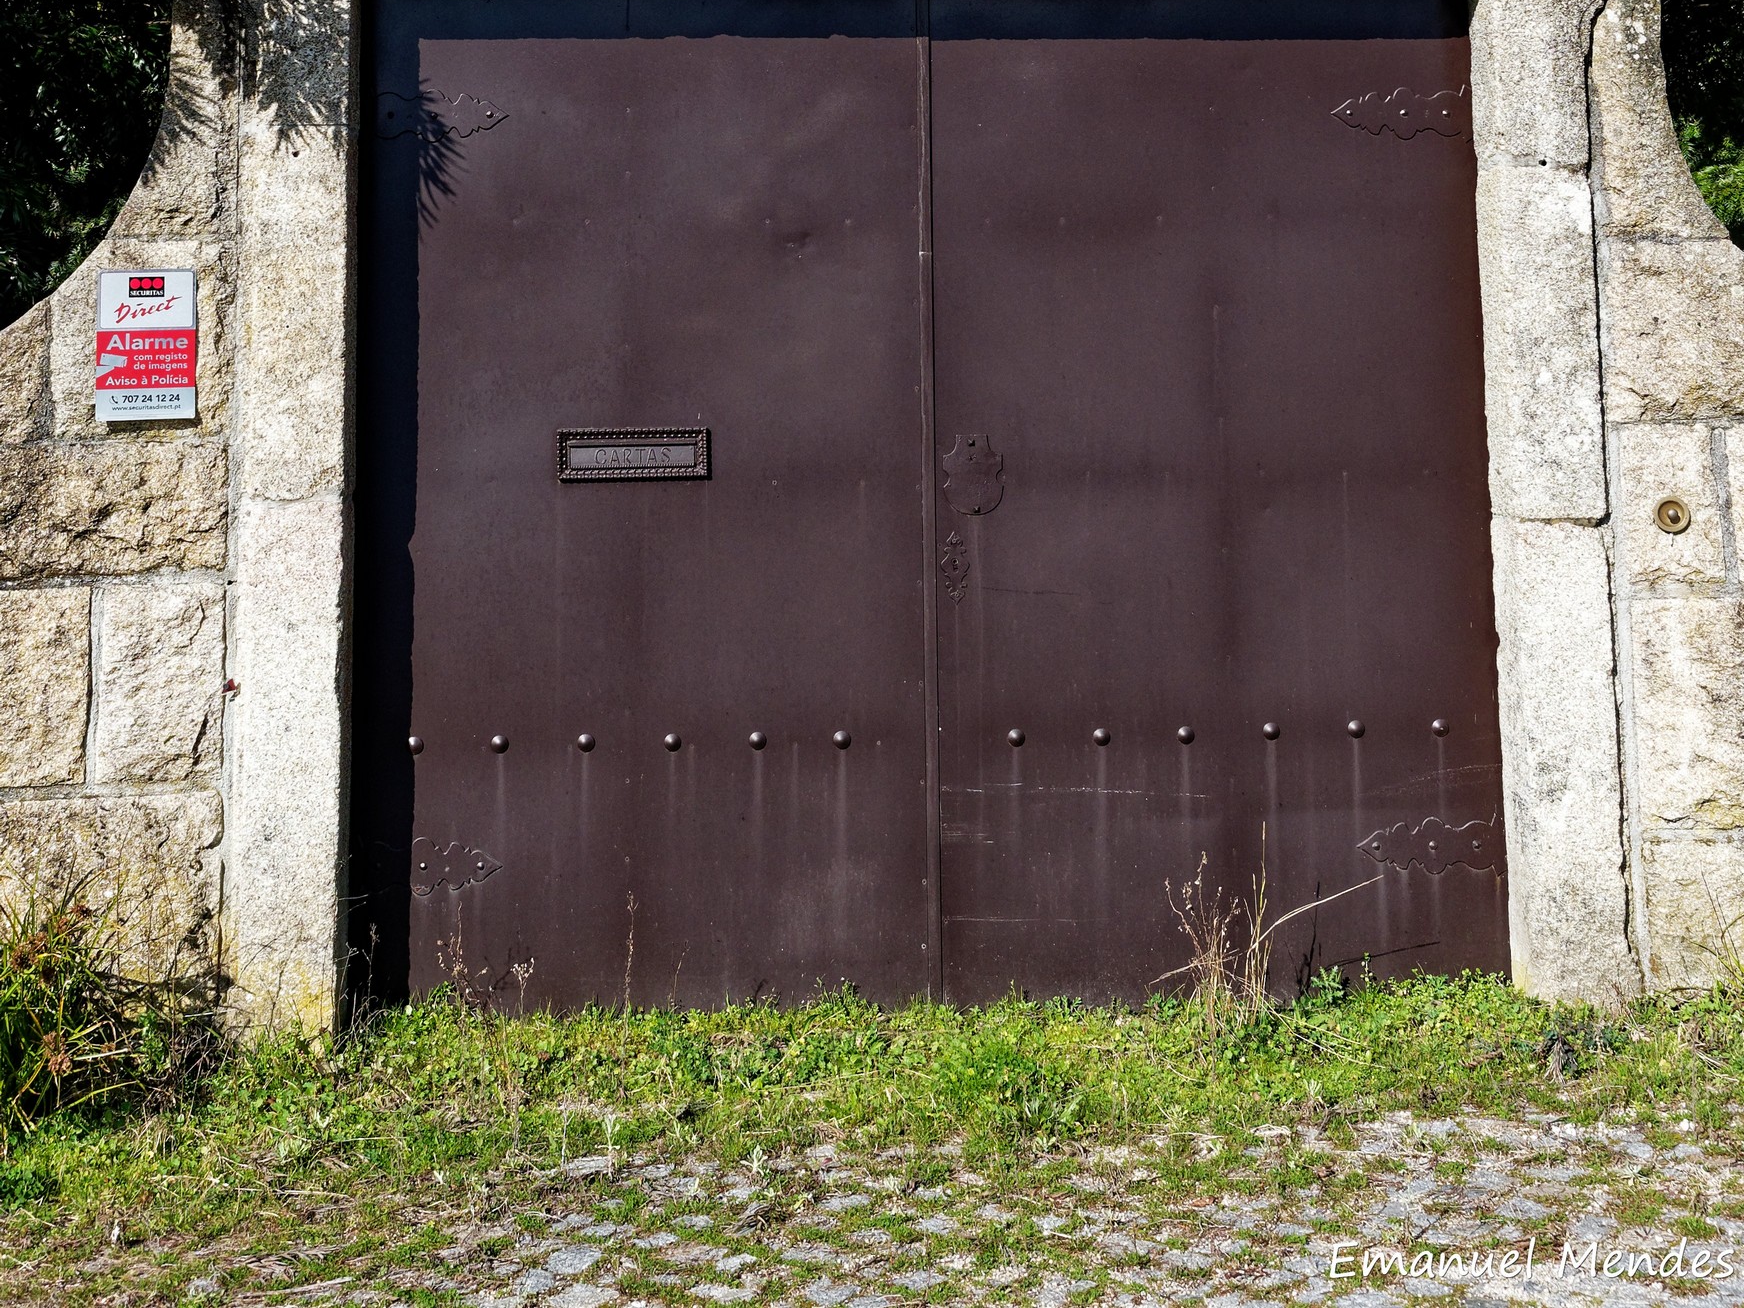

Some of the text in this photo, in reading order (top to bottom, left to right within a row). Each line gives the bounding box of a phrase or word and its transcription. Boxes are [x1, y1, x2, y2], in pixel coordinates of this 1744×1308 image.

[114, 295, 182, 324] Direct
[106, 333, 189, 350] Alarme
[155, 352, 188, 362] registo
[133, 361, 188, 371] de imagens
[105, 374, 189, 386] Aviso à Polícia
[122, 394, 180, 403] 707 24 12 24
[595, 447, 672, 465] CARTAS
